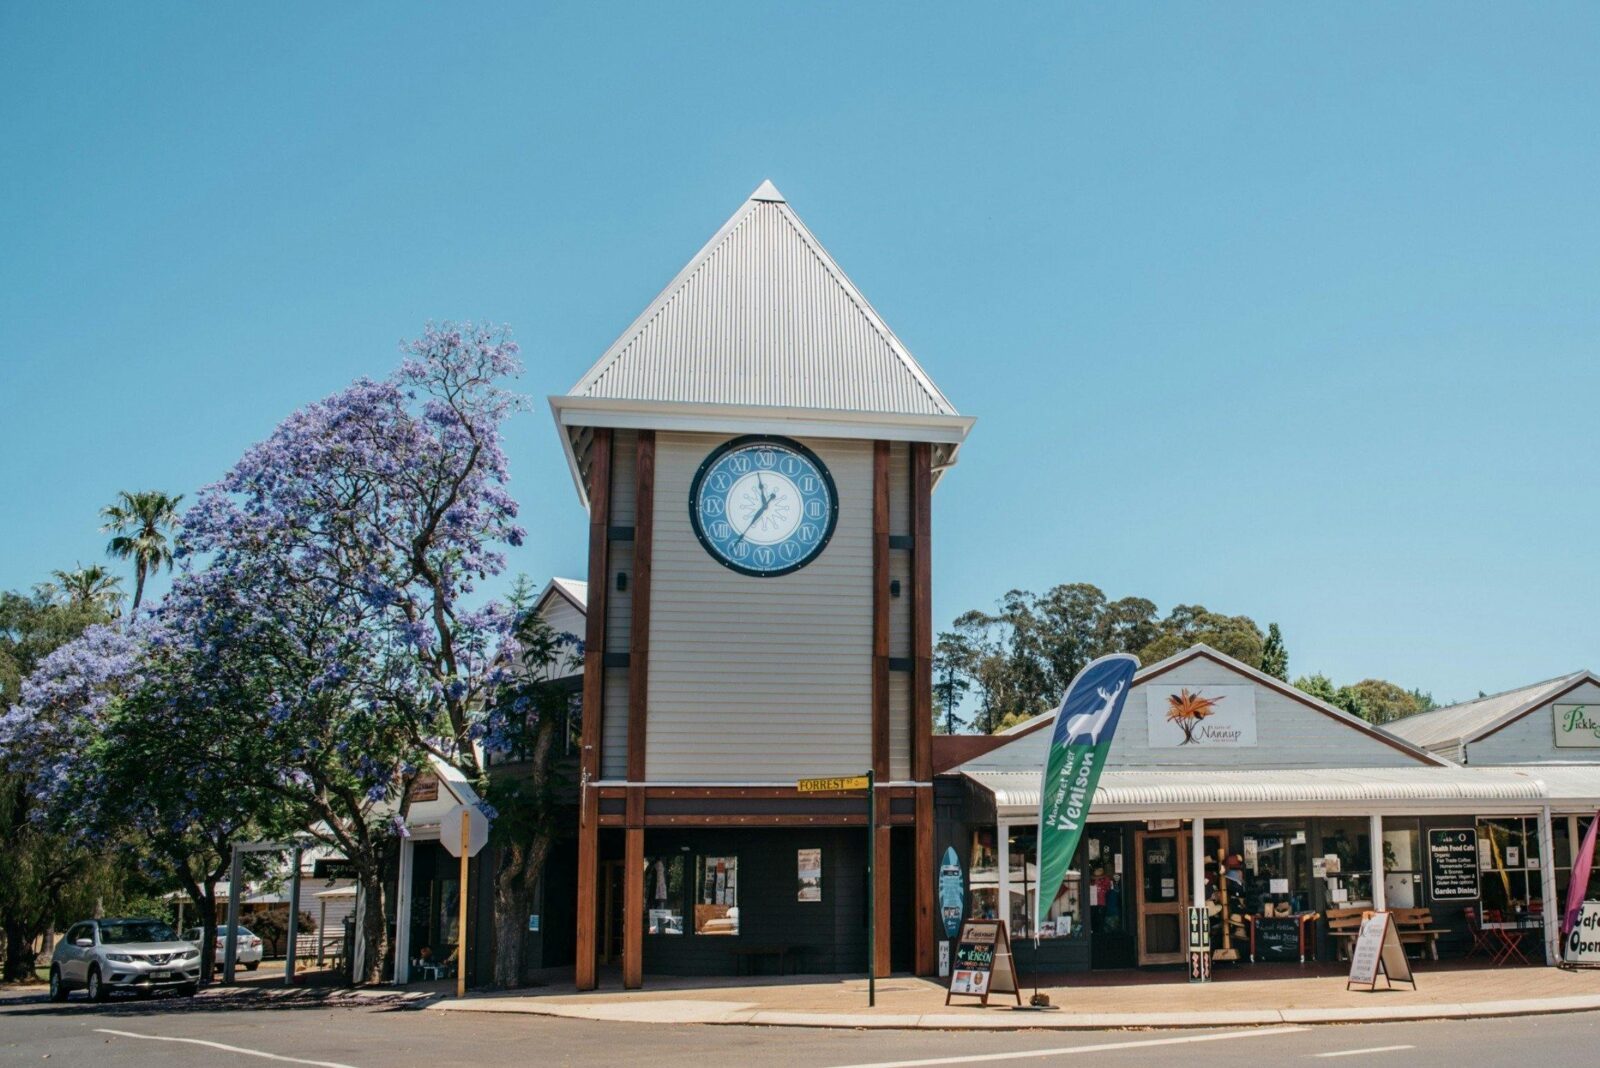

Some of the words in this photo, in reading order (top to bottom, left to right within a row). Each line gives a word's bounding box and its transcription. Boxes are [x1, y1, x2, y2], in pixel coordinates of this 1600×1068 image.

[733, 459, 747, 471] XI
[759, 453, 773, 465] XII
[788, 460, 793, 473] I
[715, 476, 726, 489] X
[804, 478, 814, 491] II
[706, 499, 721, 512] IX
[811, 503, 820, 516] III
[713, 525, 728, 538] VIII
[802, 525, 815, 538] IV
[732, 544, 746, 556] VII
[785, 544, 795, 557] V
[758, 550, 770, 564] VI
[1563, 705, 1596, 733] Pickle
[1195, 725, 1242, 741] Nannup
[800, 779, 844, 791] FORREST
[1046, 778, 1068, 827] Margaret
[1061, 750, 1075, 775] River
[1057, 752, 1095, 830] Venison
[1149, 855, 1167, 864] OPEN
[1457, 887, 1477, 895] Dining
[1191, 908, 1199, 944] ATM
[967, 951, 992, 962] VENISON
